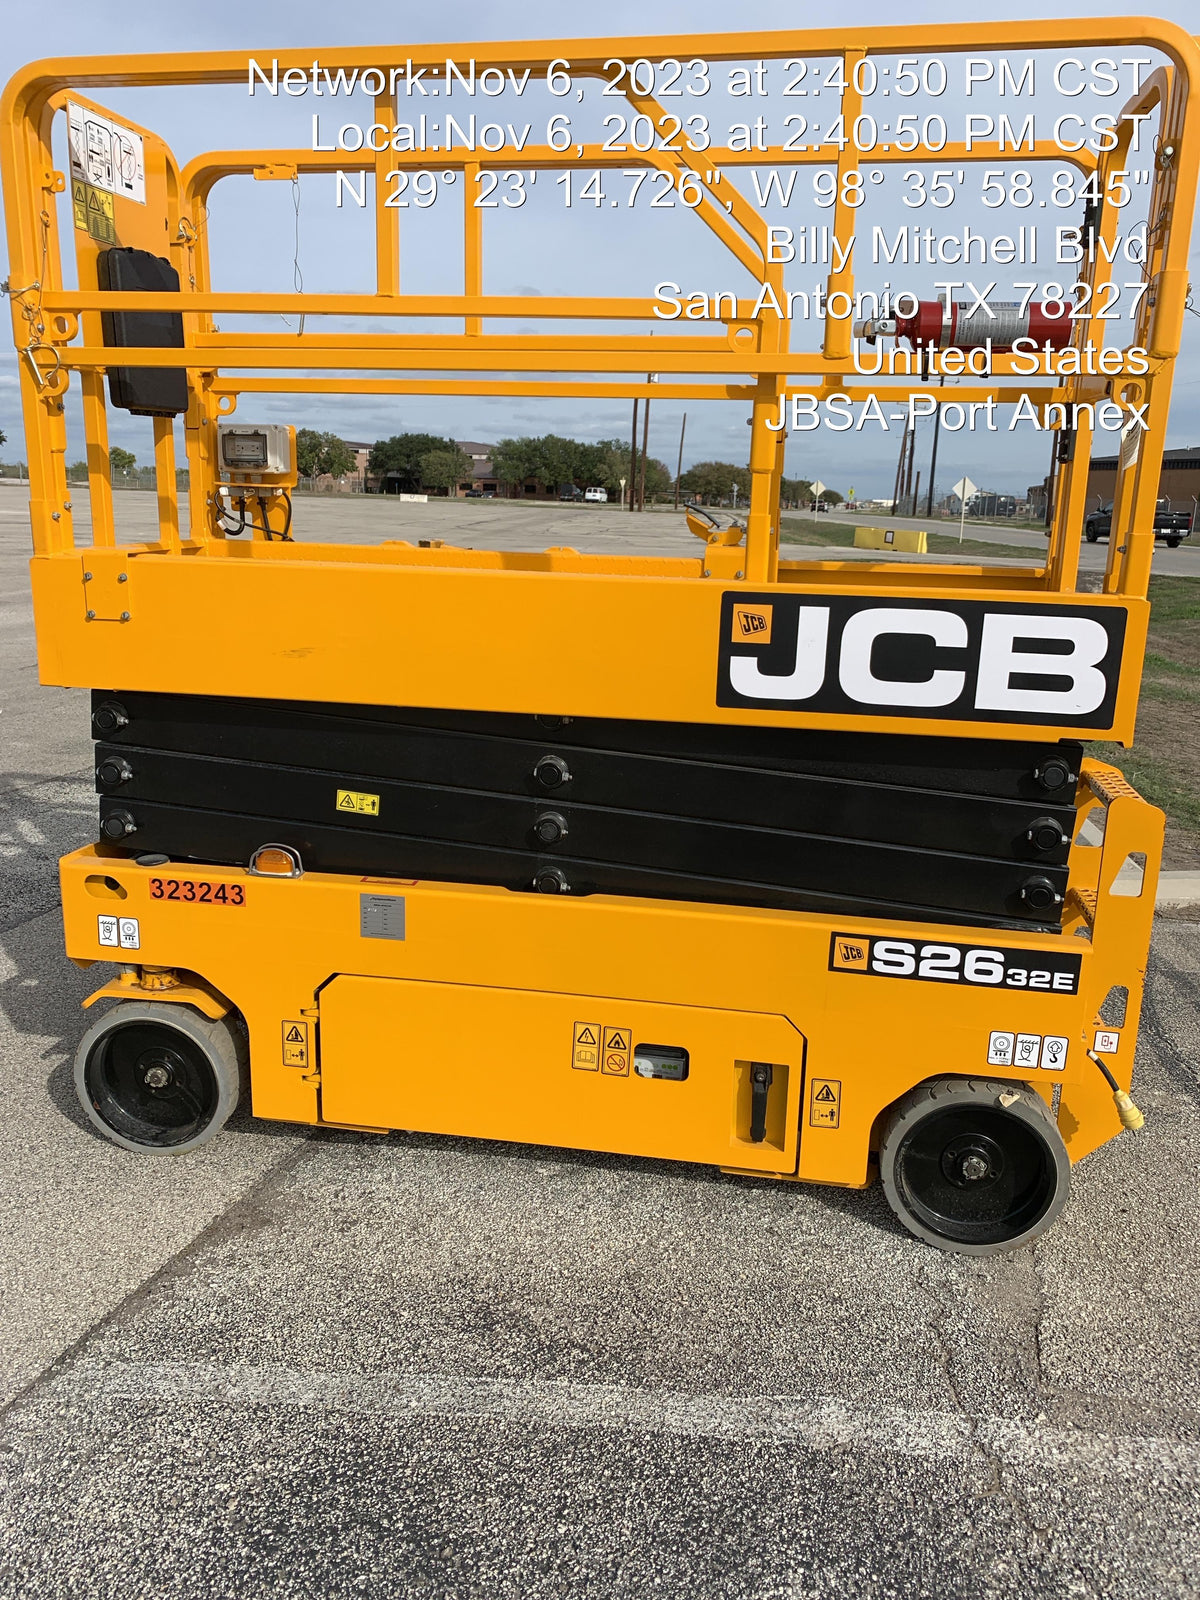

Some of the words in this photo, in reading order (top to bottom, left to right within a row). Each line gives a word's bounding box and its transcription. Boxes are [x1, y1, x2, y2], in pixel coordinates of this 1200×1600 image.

[743, 614, 765, 632] JCB
[729, 606, 1109, 715] JCB
[151, 879, 244, 905] 323243
[843, 945, 863, 961] JCB
